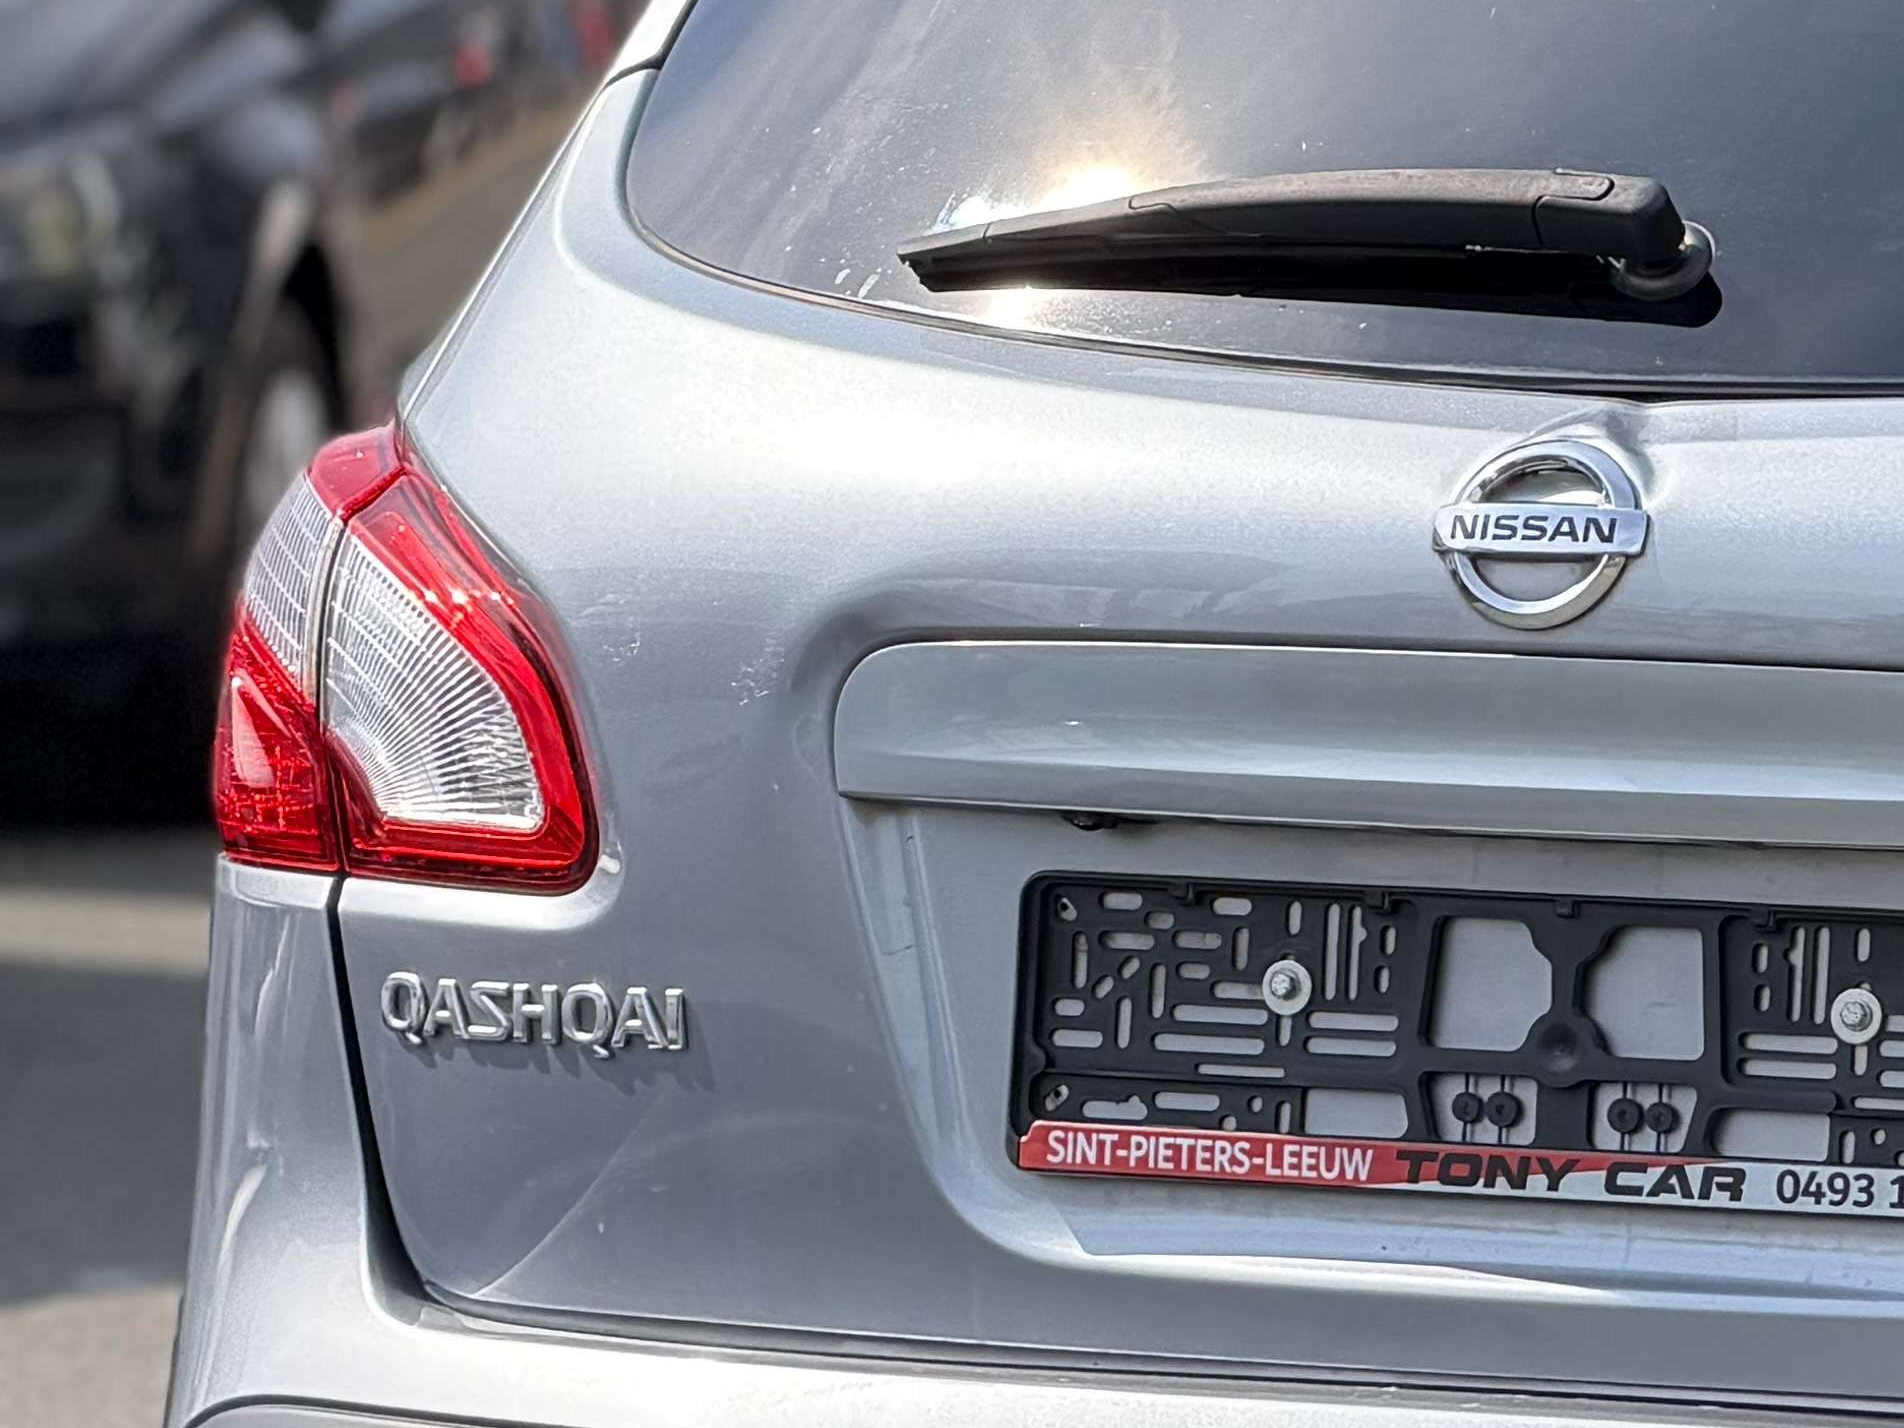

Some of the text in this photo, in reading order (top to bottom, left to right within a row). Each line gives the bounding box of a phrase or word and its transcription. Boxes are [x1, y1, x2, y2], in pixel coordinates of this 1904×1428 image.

[1449, 513, 1618, 544] NISSAN
[380, 970, 687, 1059] QASHQAI
[1045, 1129, 1374, 1182] SINT-PIETERS-LEEUW
[1395, 1149, 1581, 1193] TONY
[1603, 1162, 1746, 1203] CAR
[1775, 1169, 1875, 1208] 0493
